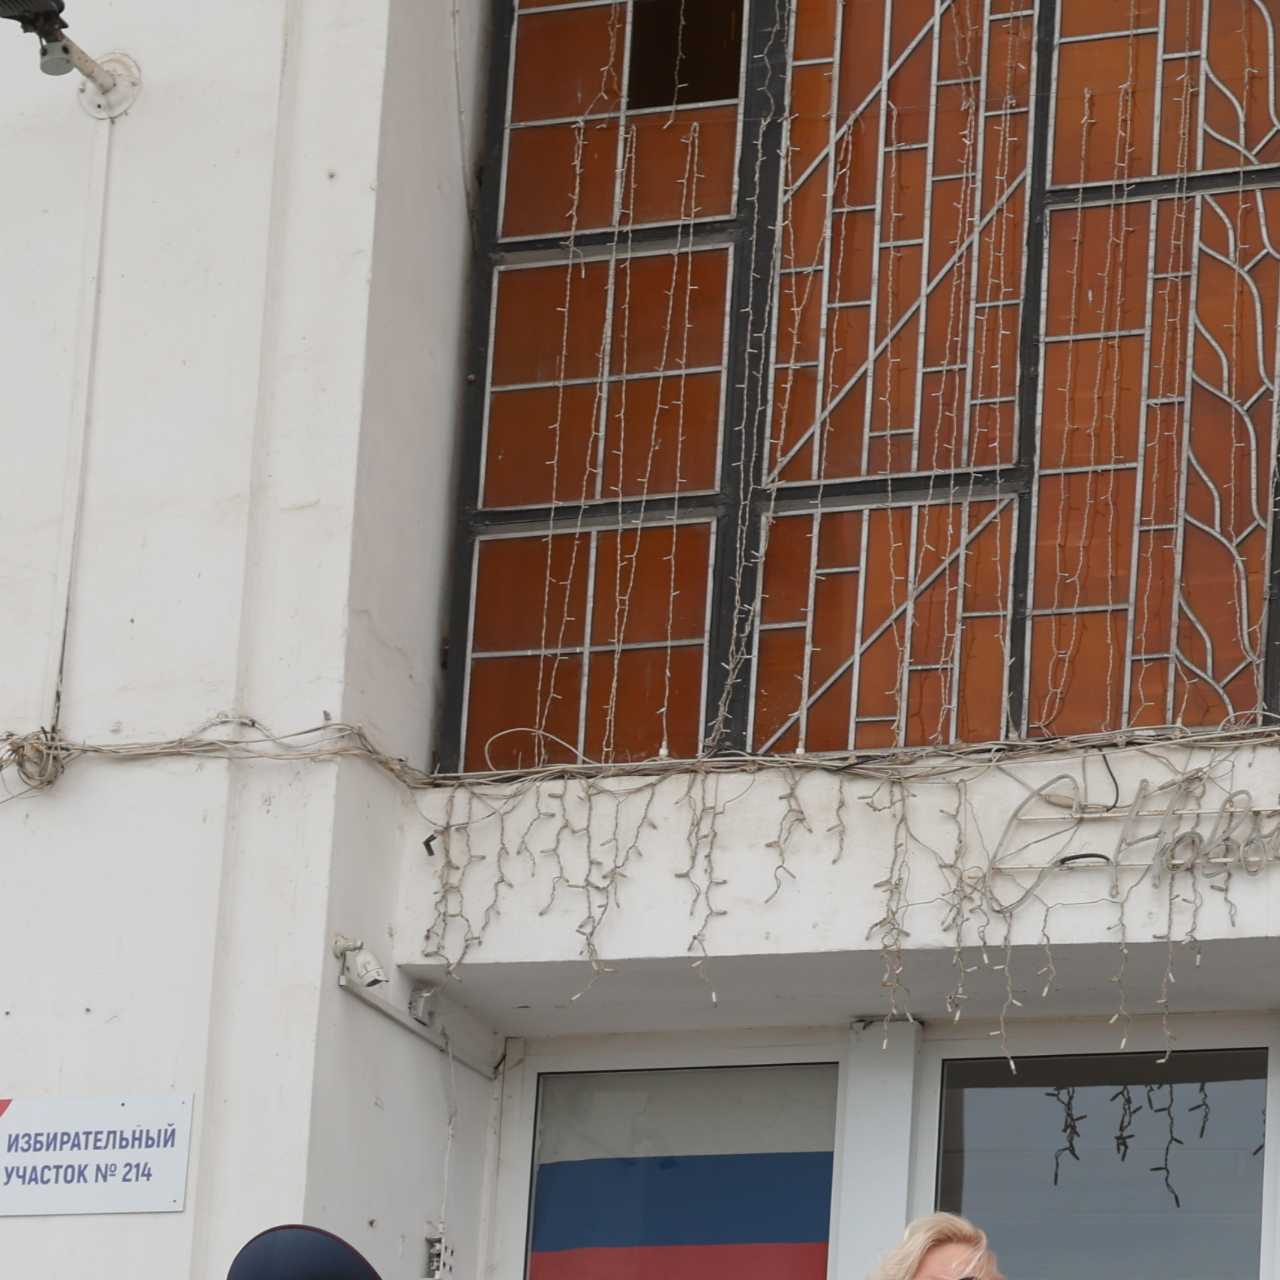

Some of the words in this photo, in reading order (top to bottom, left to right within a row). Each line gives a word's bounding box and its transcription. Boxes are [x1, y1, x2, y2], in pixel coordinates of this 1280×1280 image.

[7, 1123, 176, 1153] ИЗБИРАТЕЛЬНЫЙ
[3, 1164, 89, 1186] УЧАСТОК
[94, 1163, 117, 1183] №
[122, 1161, 153, 1183] 214
